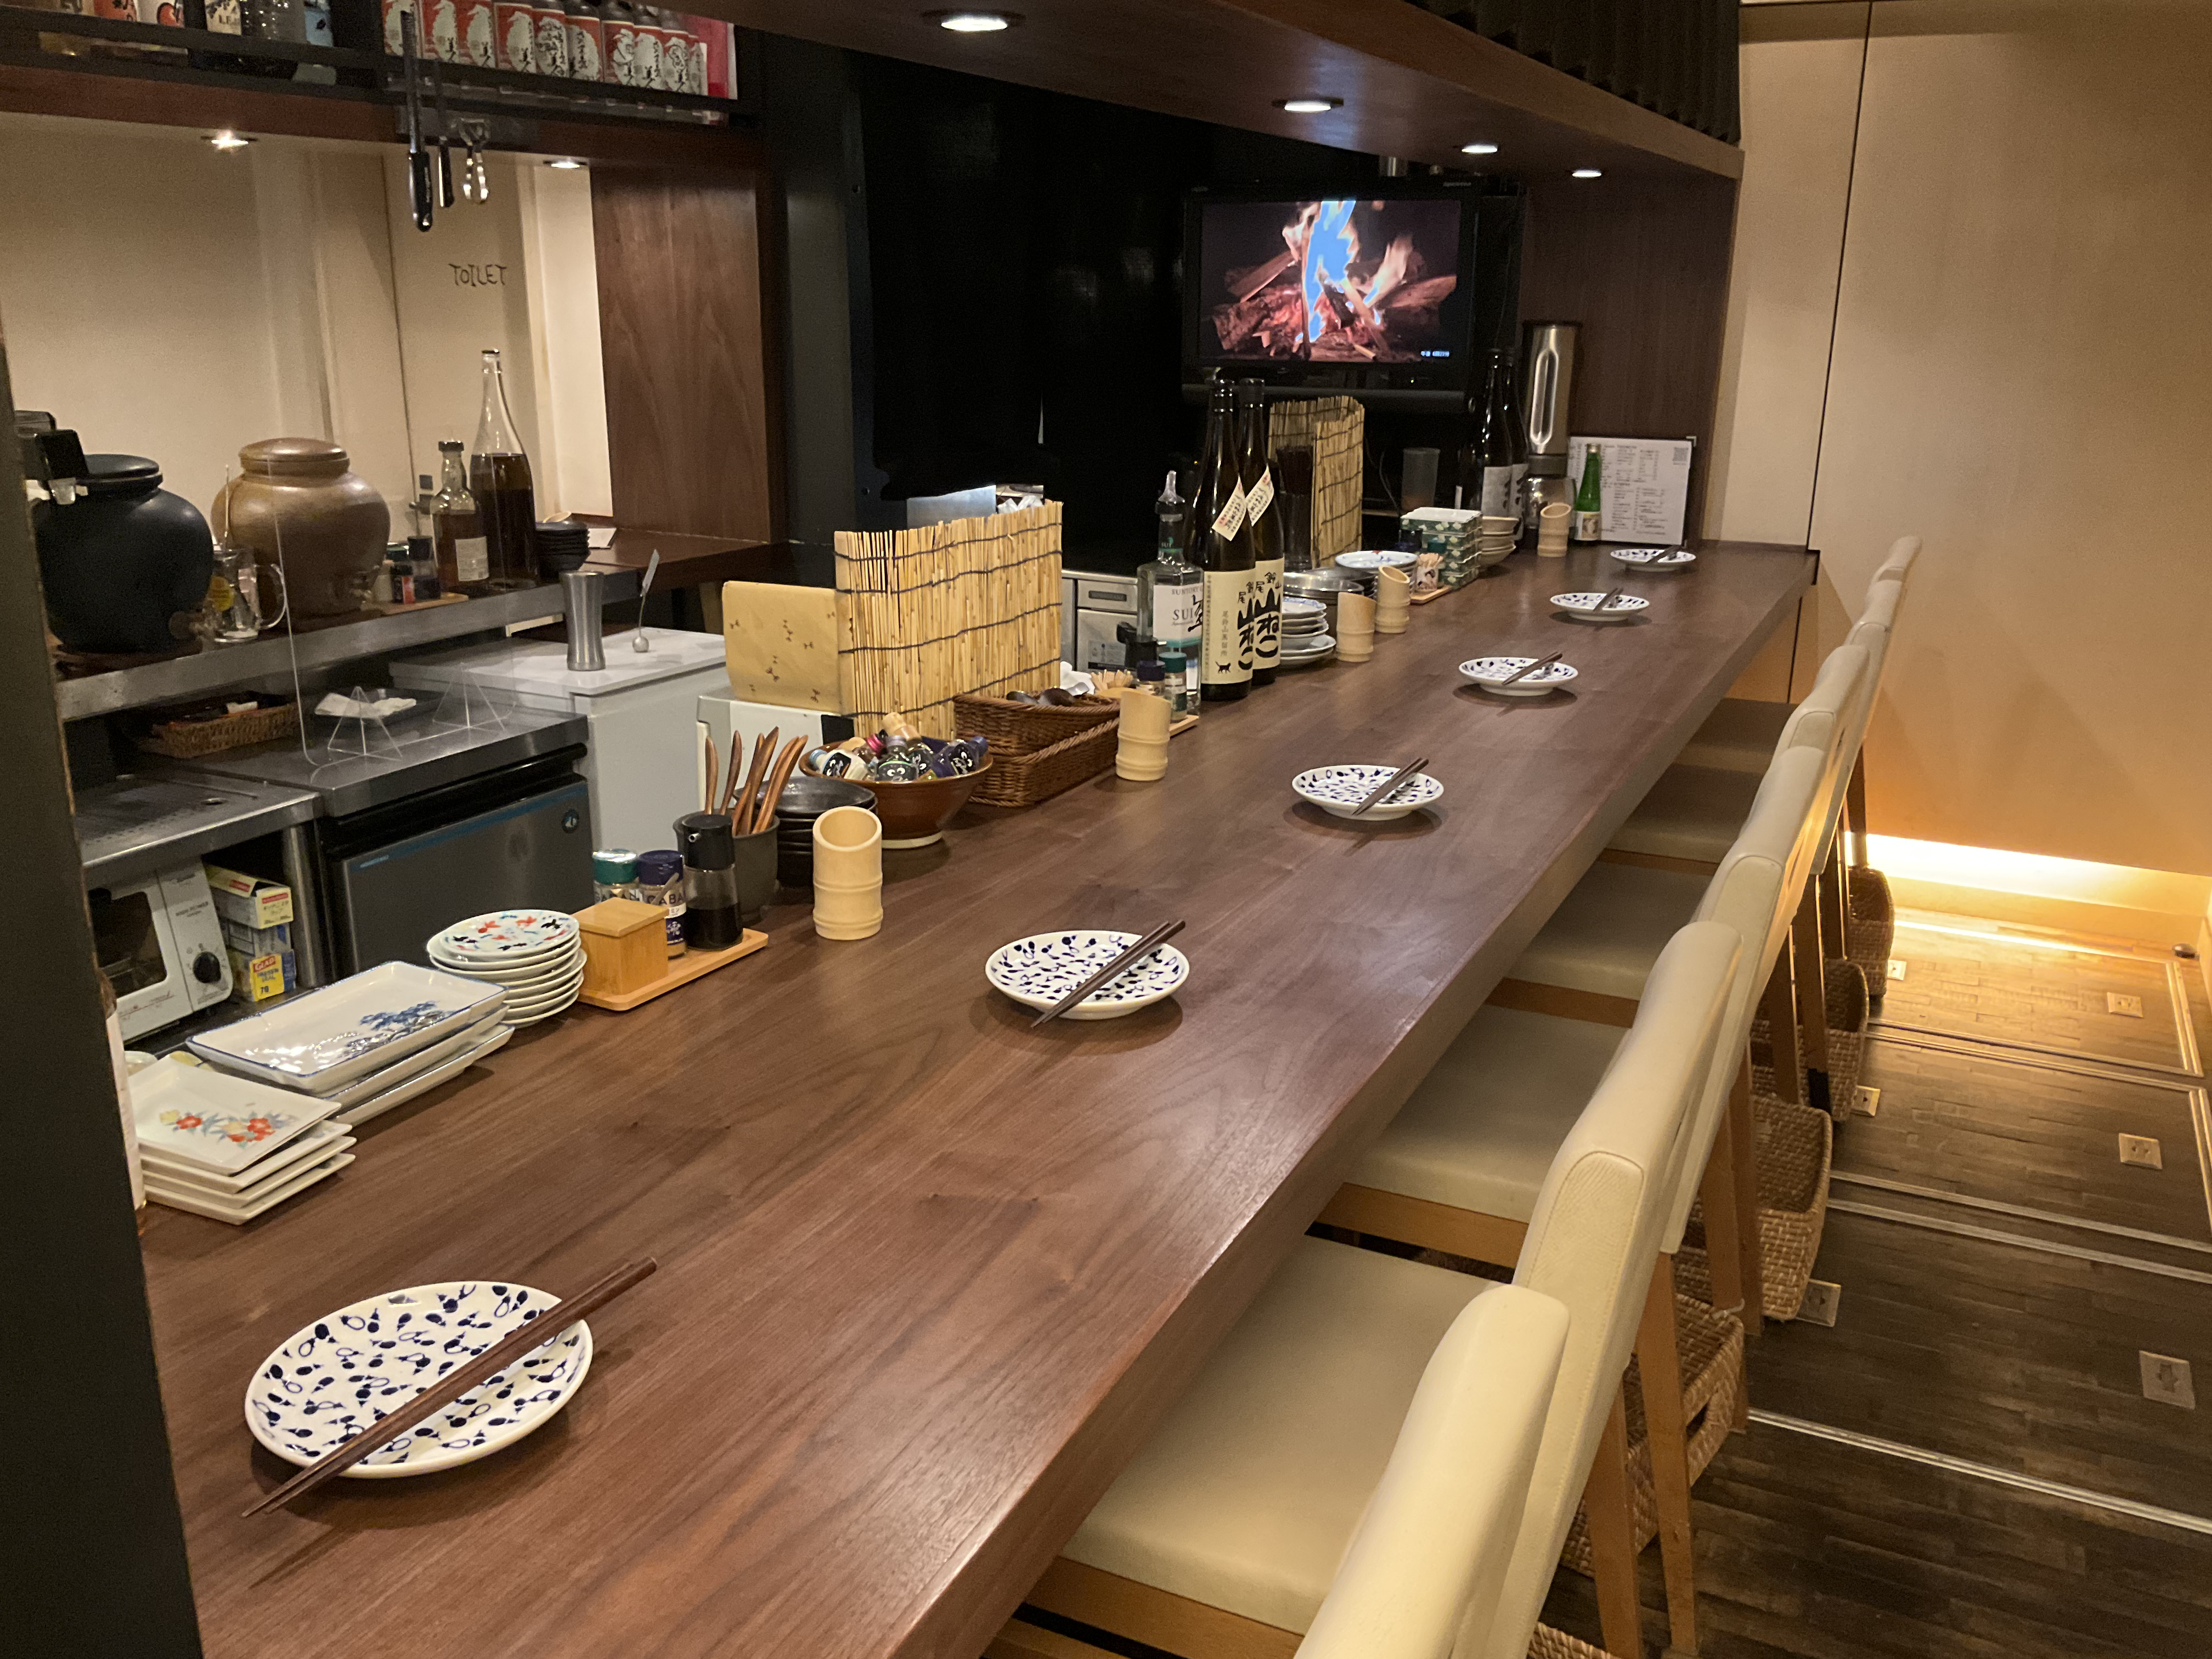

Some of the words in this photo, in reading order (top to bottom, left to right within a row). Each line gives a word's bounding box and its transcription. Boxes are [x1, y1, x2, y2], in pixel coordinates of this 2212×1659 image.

[448, 263, 507, 286] TOILET
[1238, 581, 1254, 603] 尾鈴
[1172, 608, 1194, 620] SUI
[1254, 587, 1281, 658] 山ねこ
[255, 957, 275, 971] GLAD
